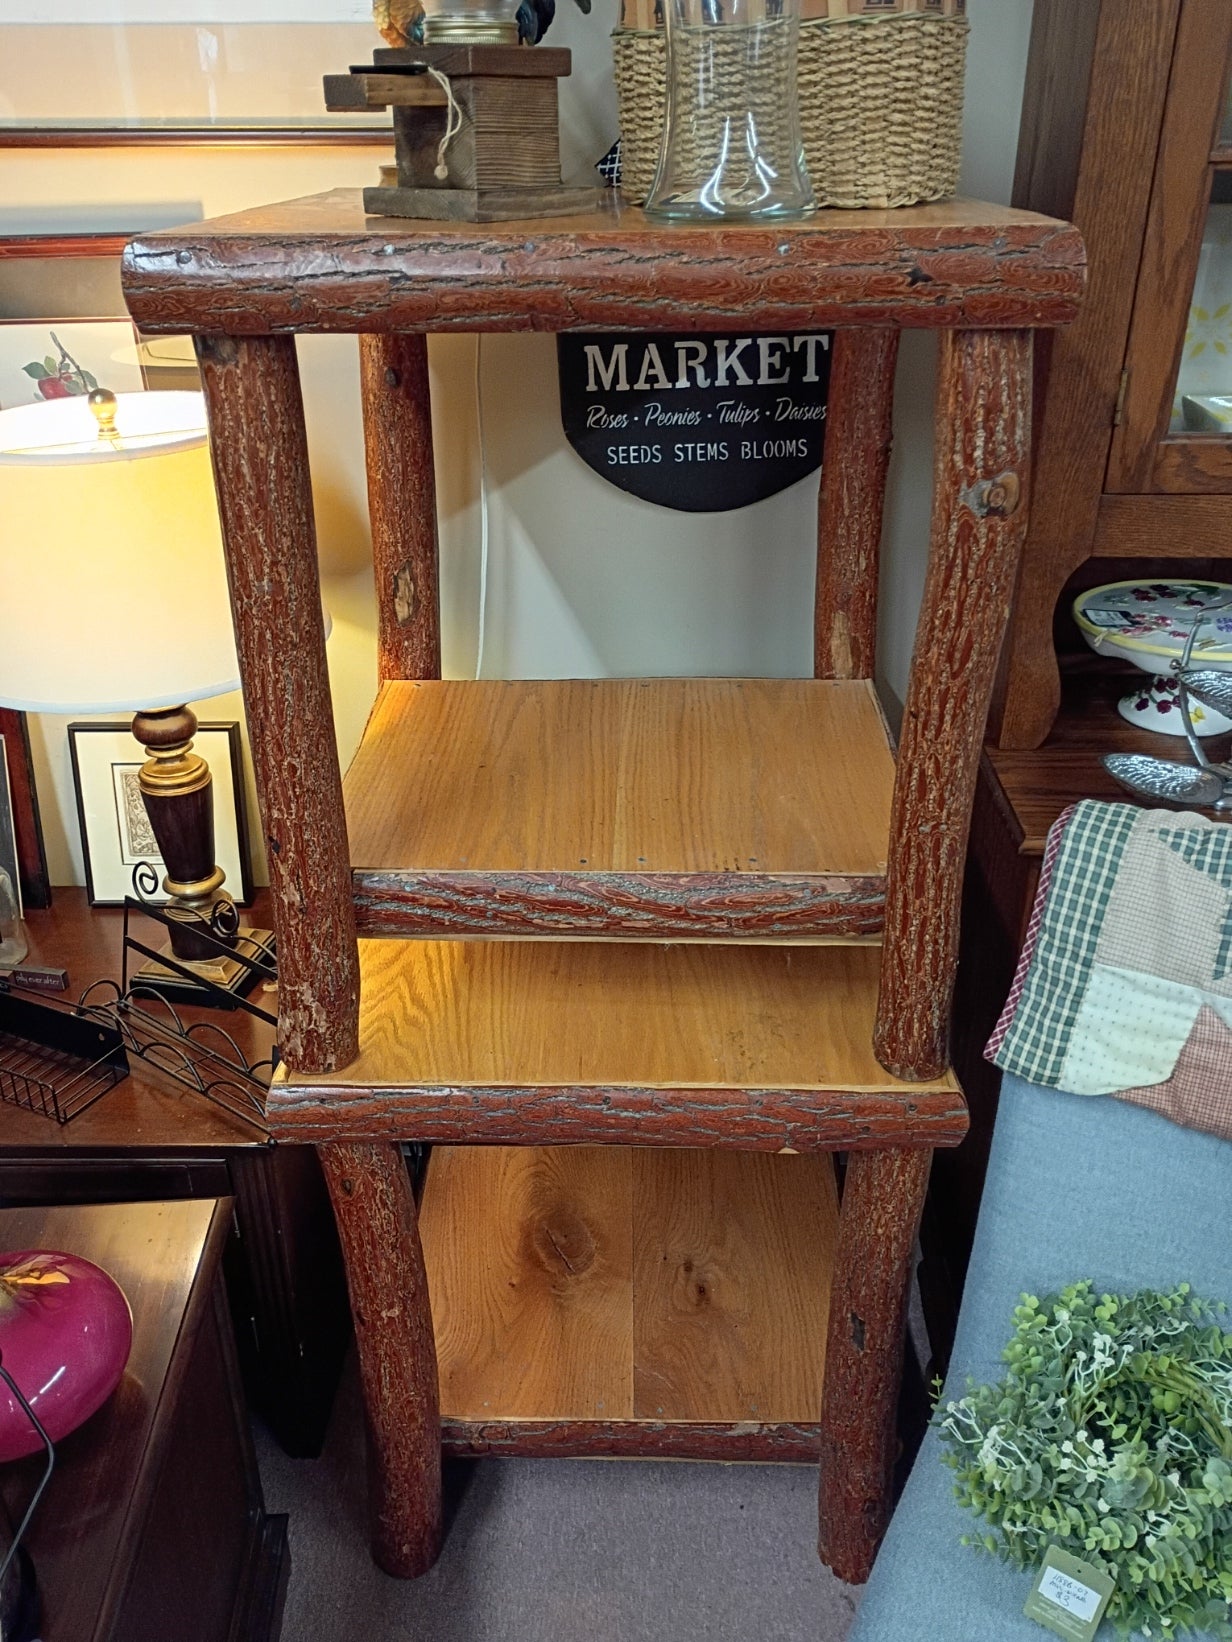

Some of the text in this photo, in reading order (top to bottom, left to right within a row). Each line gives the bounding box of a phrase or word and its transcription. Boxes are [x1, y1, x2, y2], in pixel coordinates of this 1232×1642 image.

[583, 335, 829, 392] MARKET
[586, 397, 828, 429] Roses Peonies Tulips Daisies
[607, 438, 808, 465] SEEDS STEMS BLOOMS
